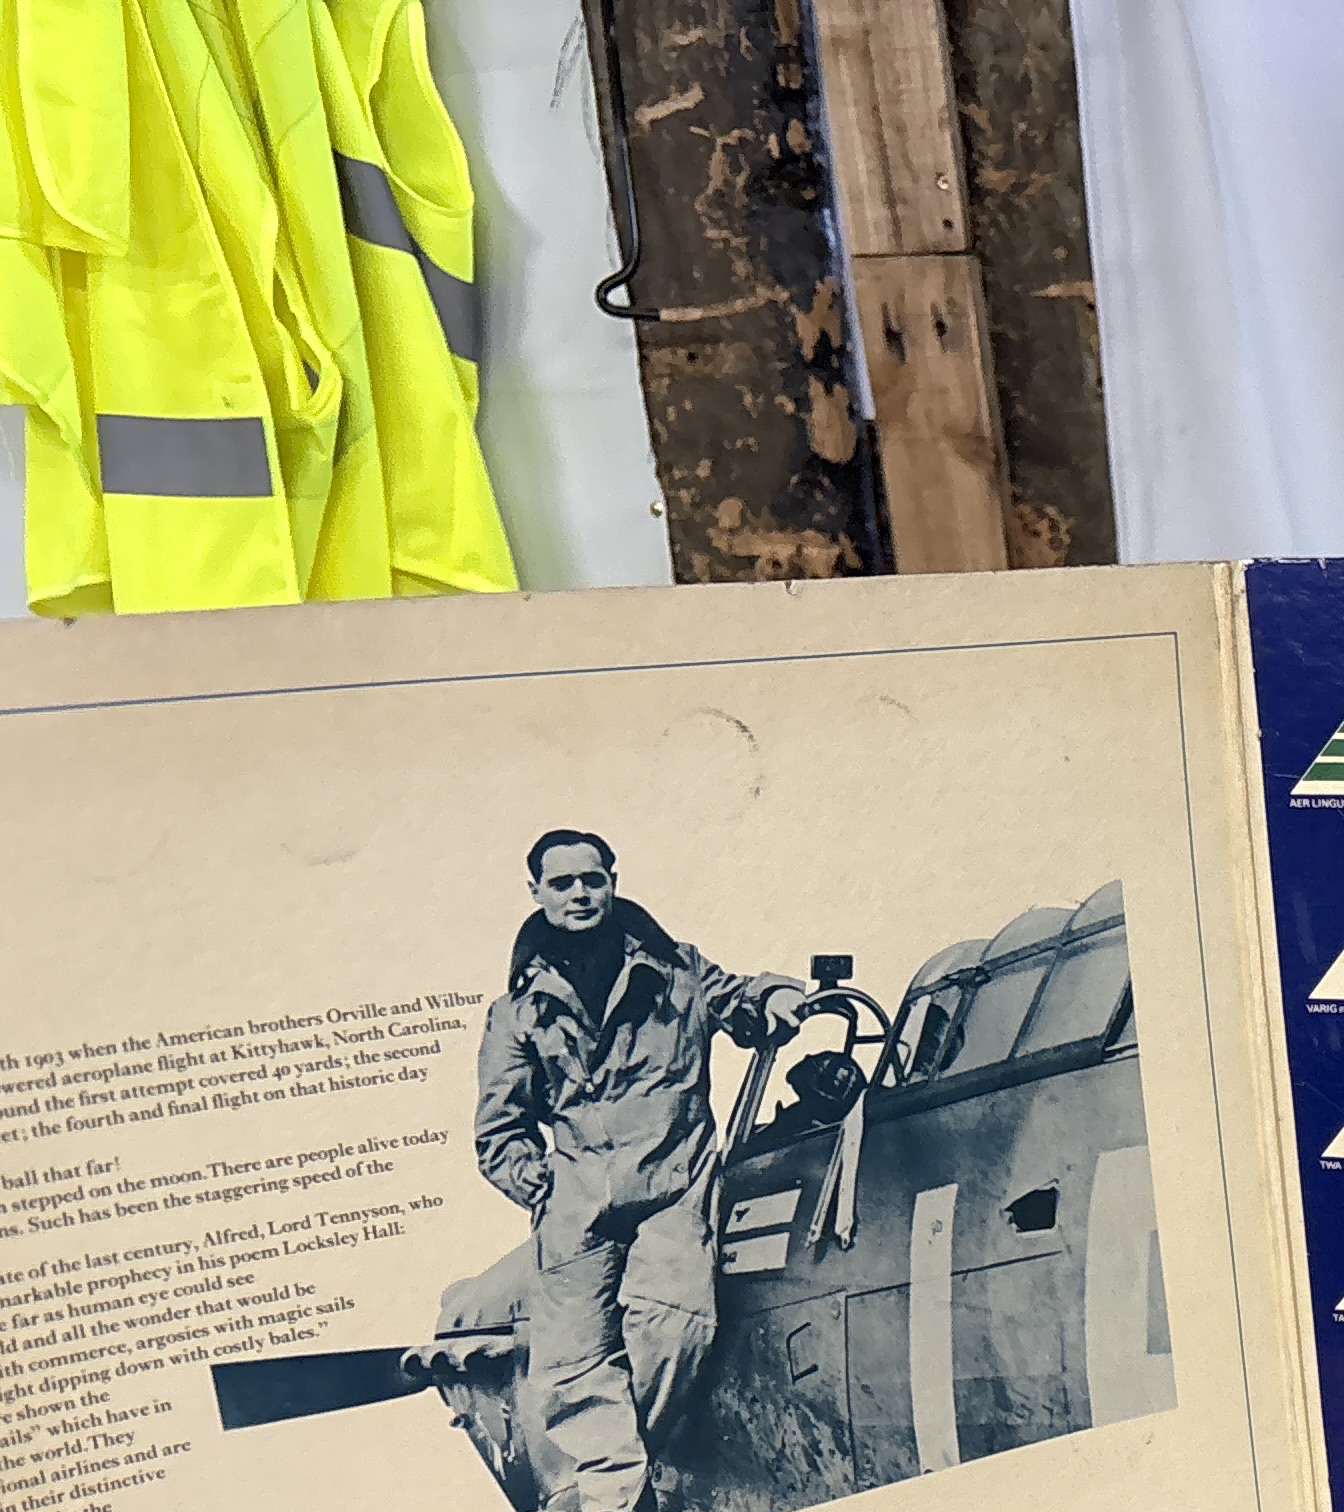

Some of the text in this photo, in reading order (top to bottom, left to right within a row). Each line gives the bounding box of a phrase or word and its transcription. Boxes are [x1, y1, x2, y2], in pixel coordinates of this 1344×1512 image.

[1289, 798, 1310, 808] AER
[25, 992, 484, 1067] 1903 when the American brothers Orville and Wilbur
[1306, 1004, 1338, 1013] VARIG
[44, 1040, 441, 1112] the first attempt covered 40 yards; the second
[62, 1018, 467, 1085] aeroplane flight at Kittyhawk, North Carolina,
[31, 1066, 428, 1138] the fourth and final flight on that historic day
[1, 1156, 119, 1190] ball that far!
[1319, 1160, 1342, 1169] TWA
[28, 1195, 443, 1279] of the last century, Alfred, Lord Tennyson, who
[87, 1221, 405, 1295] prophecy in his poem Locksley Hall:
[22, 1283, 316, 1351] and all the wonder that would be
[51, 1442, 191, 1482] airlines and are
